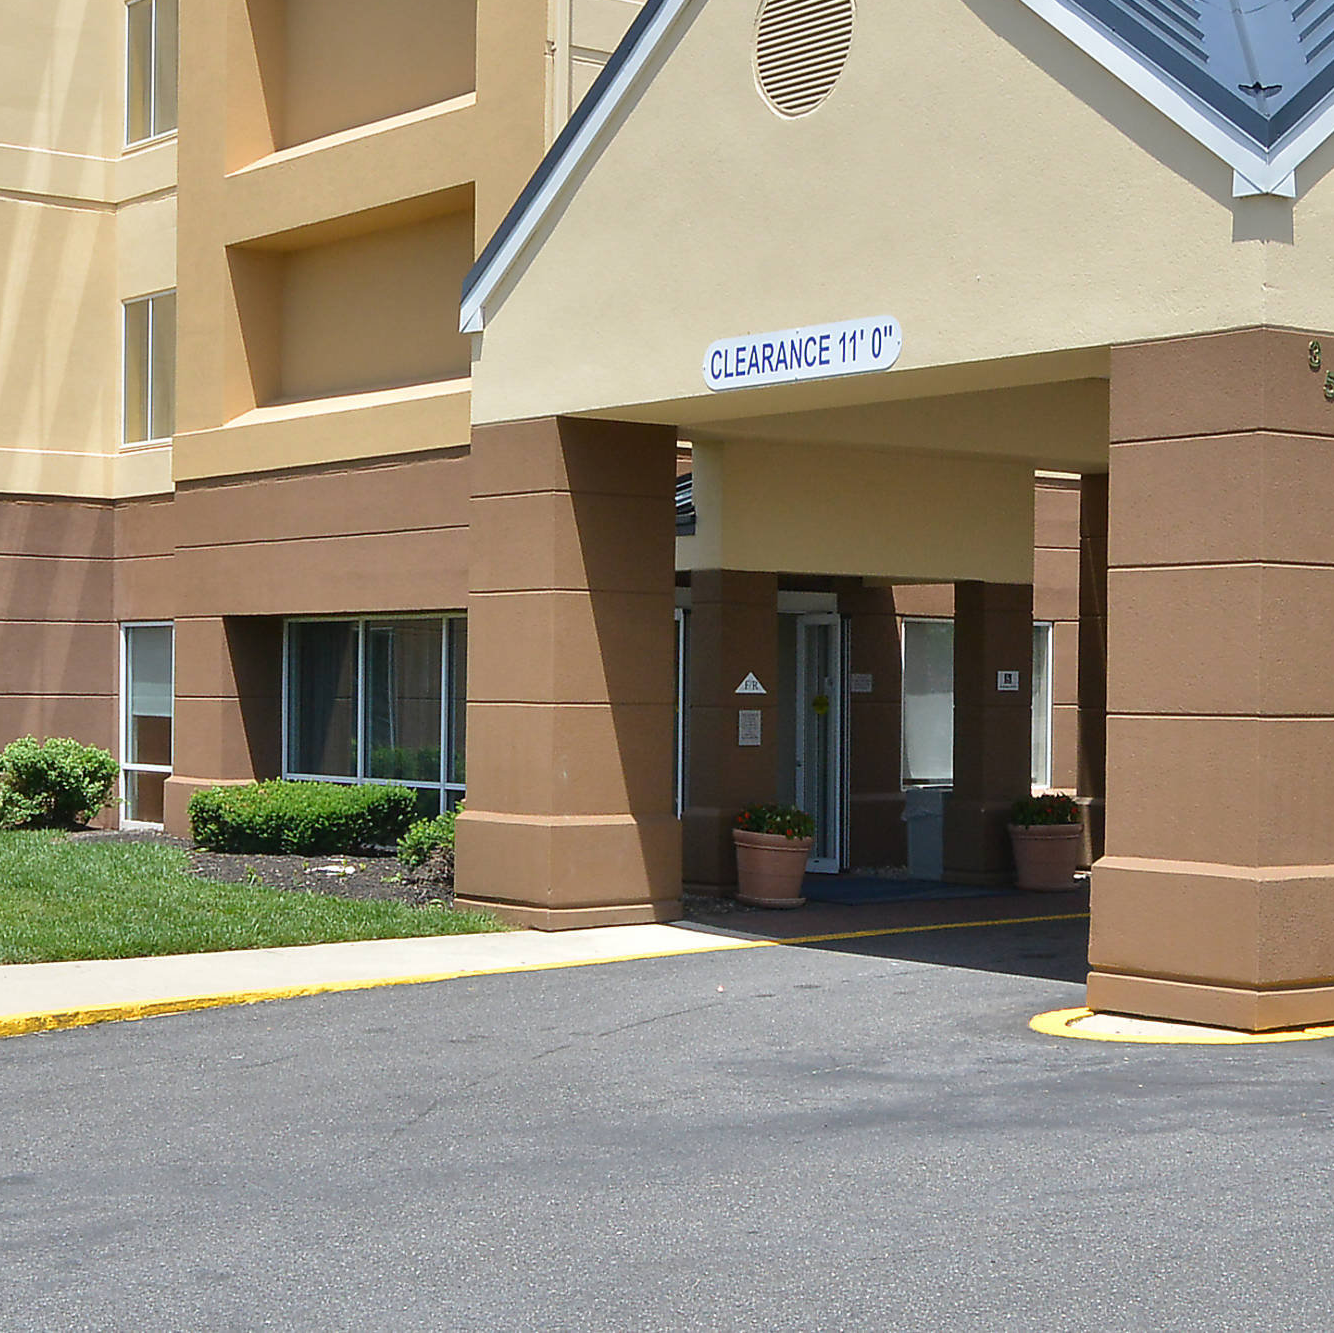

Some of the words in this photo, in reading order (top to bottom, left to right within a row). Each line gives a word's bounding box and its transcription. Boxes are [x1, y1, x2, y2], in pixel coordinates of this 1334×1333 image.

[710, 334, 831, 380] CLEARANCE
[838, 329, 865, 363] 11'
[871, 324, 893, 359] 0"
